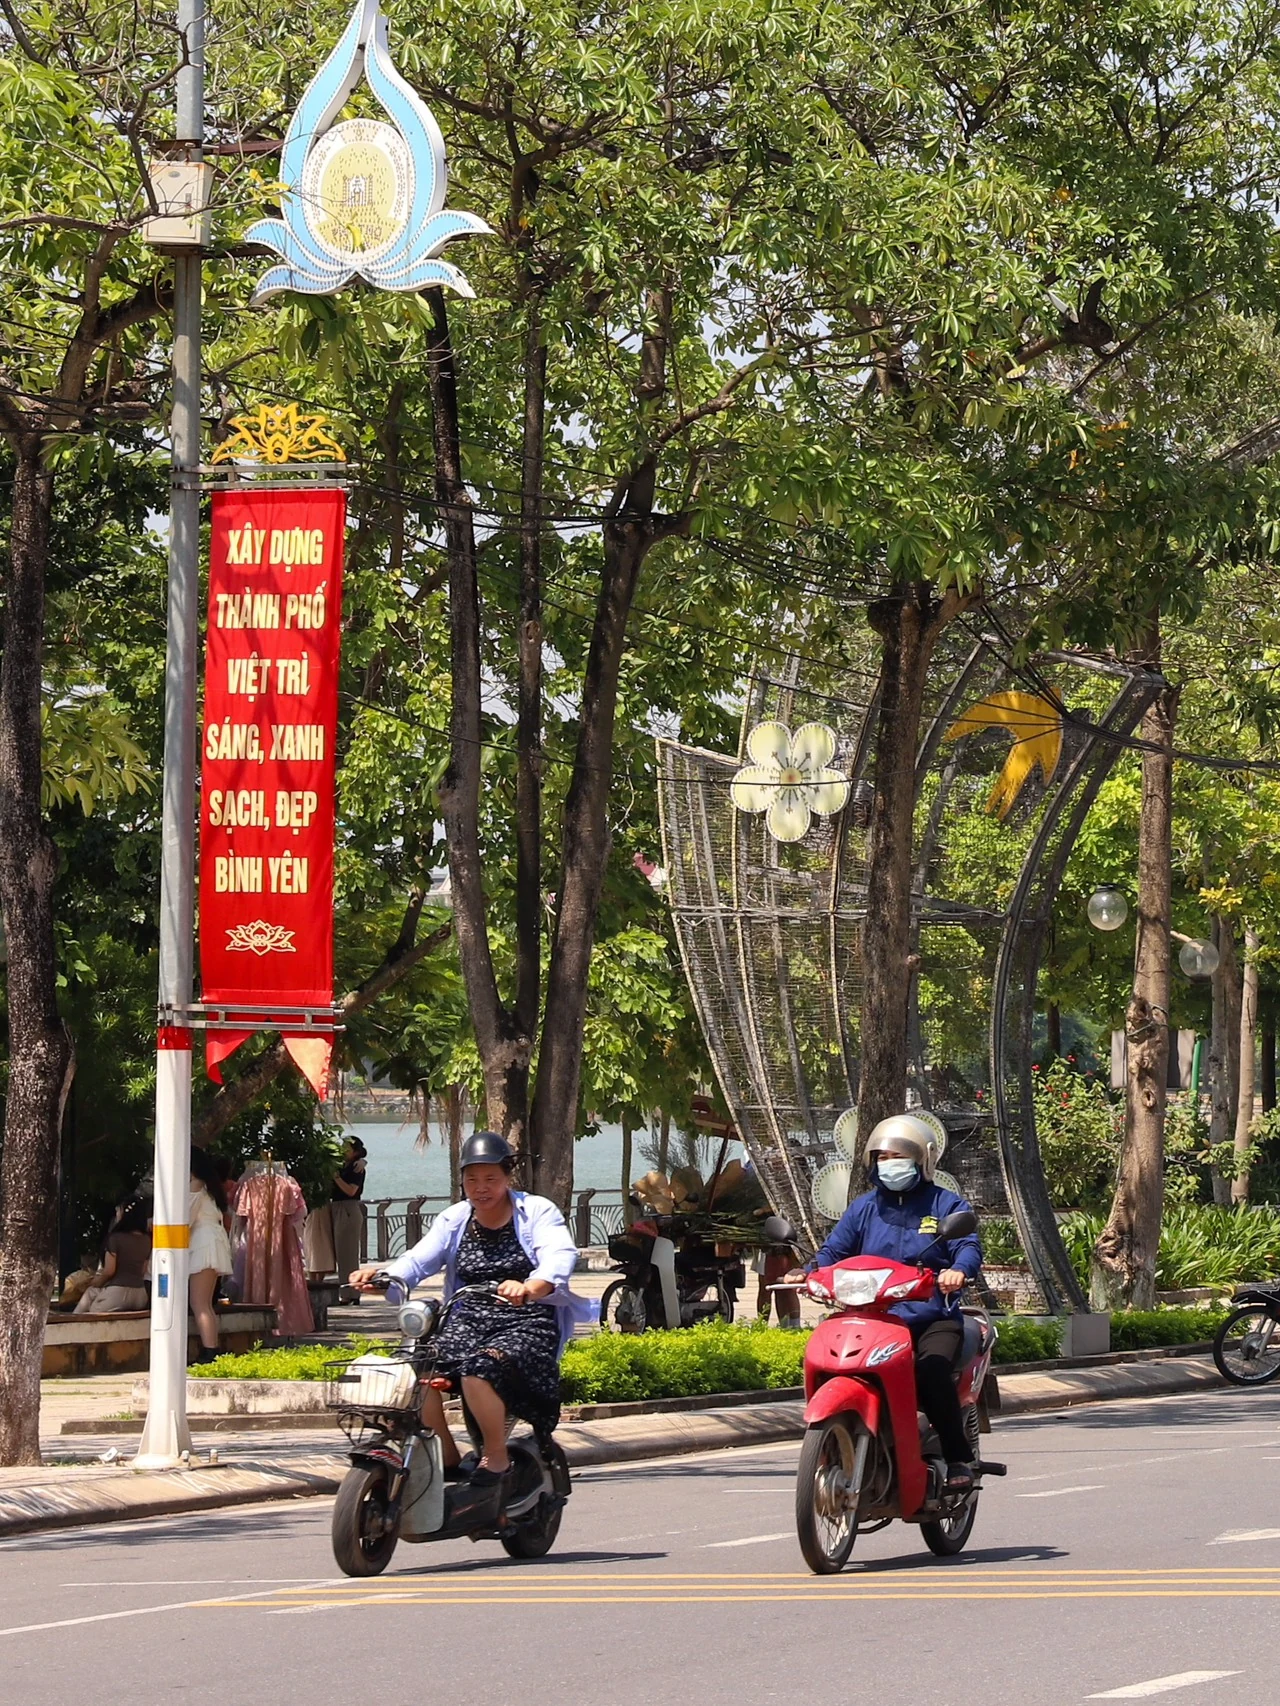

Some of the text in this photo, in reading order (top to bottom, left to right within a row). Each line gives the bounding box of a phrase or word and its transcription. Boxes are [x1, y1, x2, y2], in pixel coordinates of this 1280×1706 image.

[225, 522, 324, 573] XÂY DỰNG
[216, 580, 328, 630] THÀNH PHỐ
[227, 651, 310, 703] VIỆT TRÌ
[206, 716, 324, 764] SÁNG, XANH
[209, 789, 318, 835] SẠCH, ĐẸP
[215, 849, 308, 894] BÌNH YÊN
